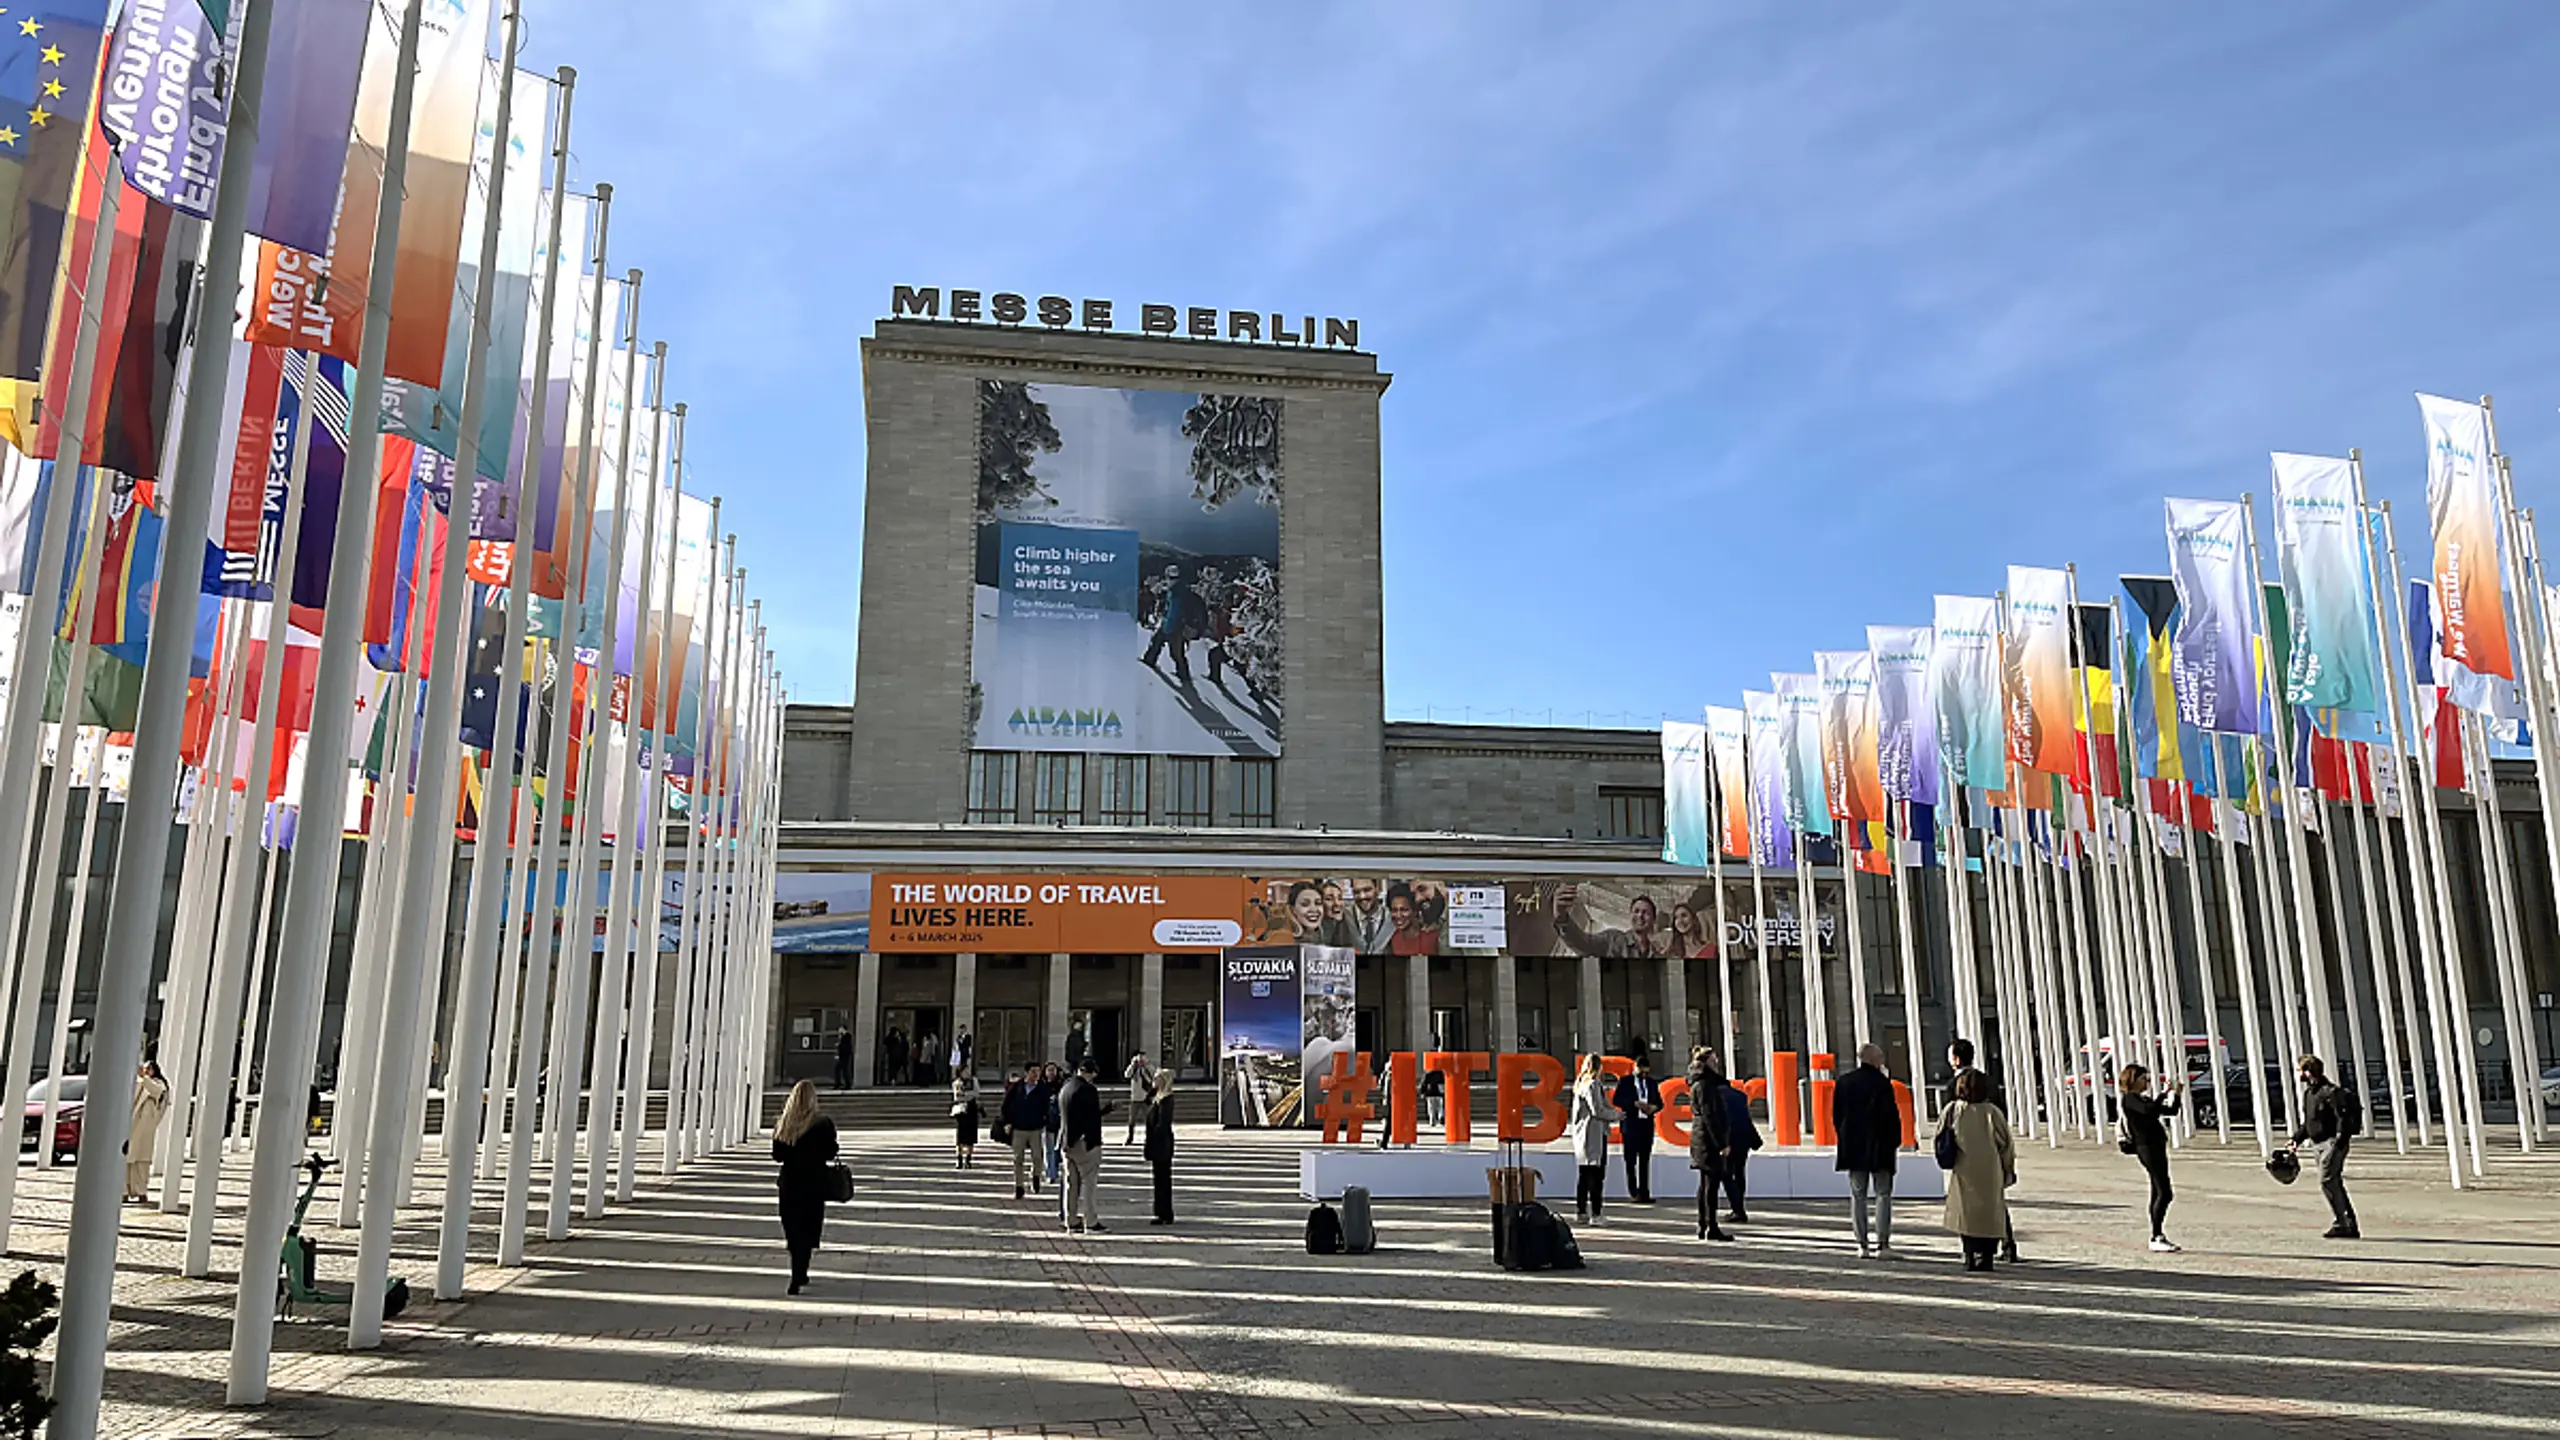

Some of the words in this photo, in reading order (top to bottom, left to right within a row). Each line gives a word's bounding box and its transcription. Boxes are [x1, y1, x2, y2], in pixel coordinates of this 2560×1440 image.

[892, 285, 1114, 330] MESSE
[1140, 303, 1359, 346] BERLIN
[1014, 545, 1062, 560] Climb
[1065, 547, 1117, 564] higher
[1014, 560, 1041, 574] the
[1044, 563, 1072, 575] sea
[1014, 576, 1067, 590] awaits
[1070, 579, 1101, 593] you
[1007, 705, 1122, 727] ALBANIA
[890, 884, 936, 904] THE
[943, 884, 1032, 905] WORLD
[1038, 884, 1072, 904] OF
[1077, 885, 1166, 905] TRAVEL
[890, 908, 957, 927] LIVES
[965, 908, 1034, 928] HERE.
[917, 932, 957, 942] MARCH
[960, 931, 984, 942] 2025
[1725, 921, 1835, 947] DIVERSY
[1228, 959, 1296, 975] SLOVAKIA
[1307, 960, 1351, 975] SLOVAKIA
